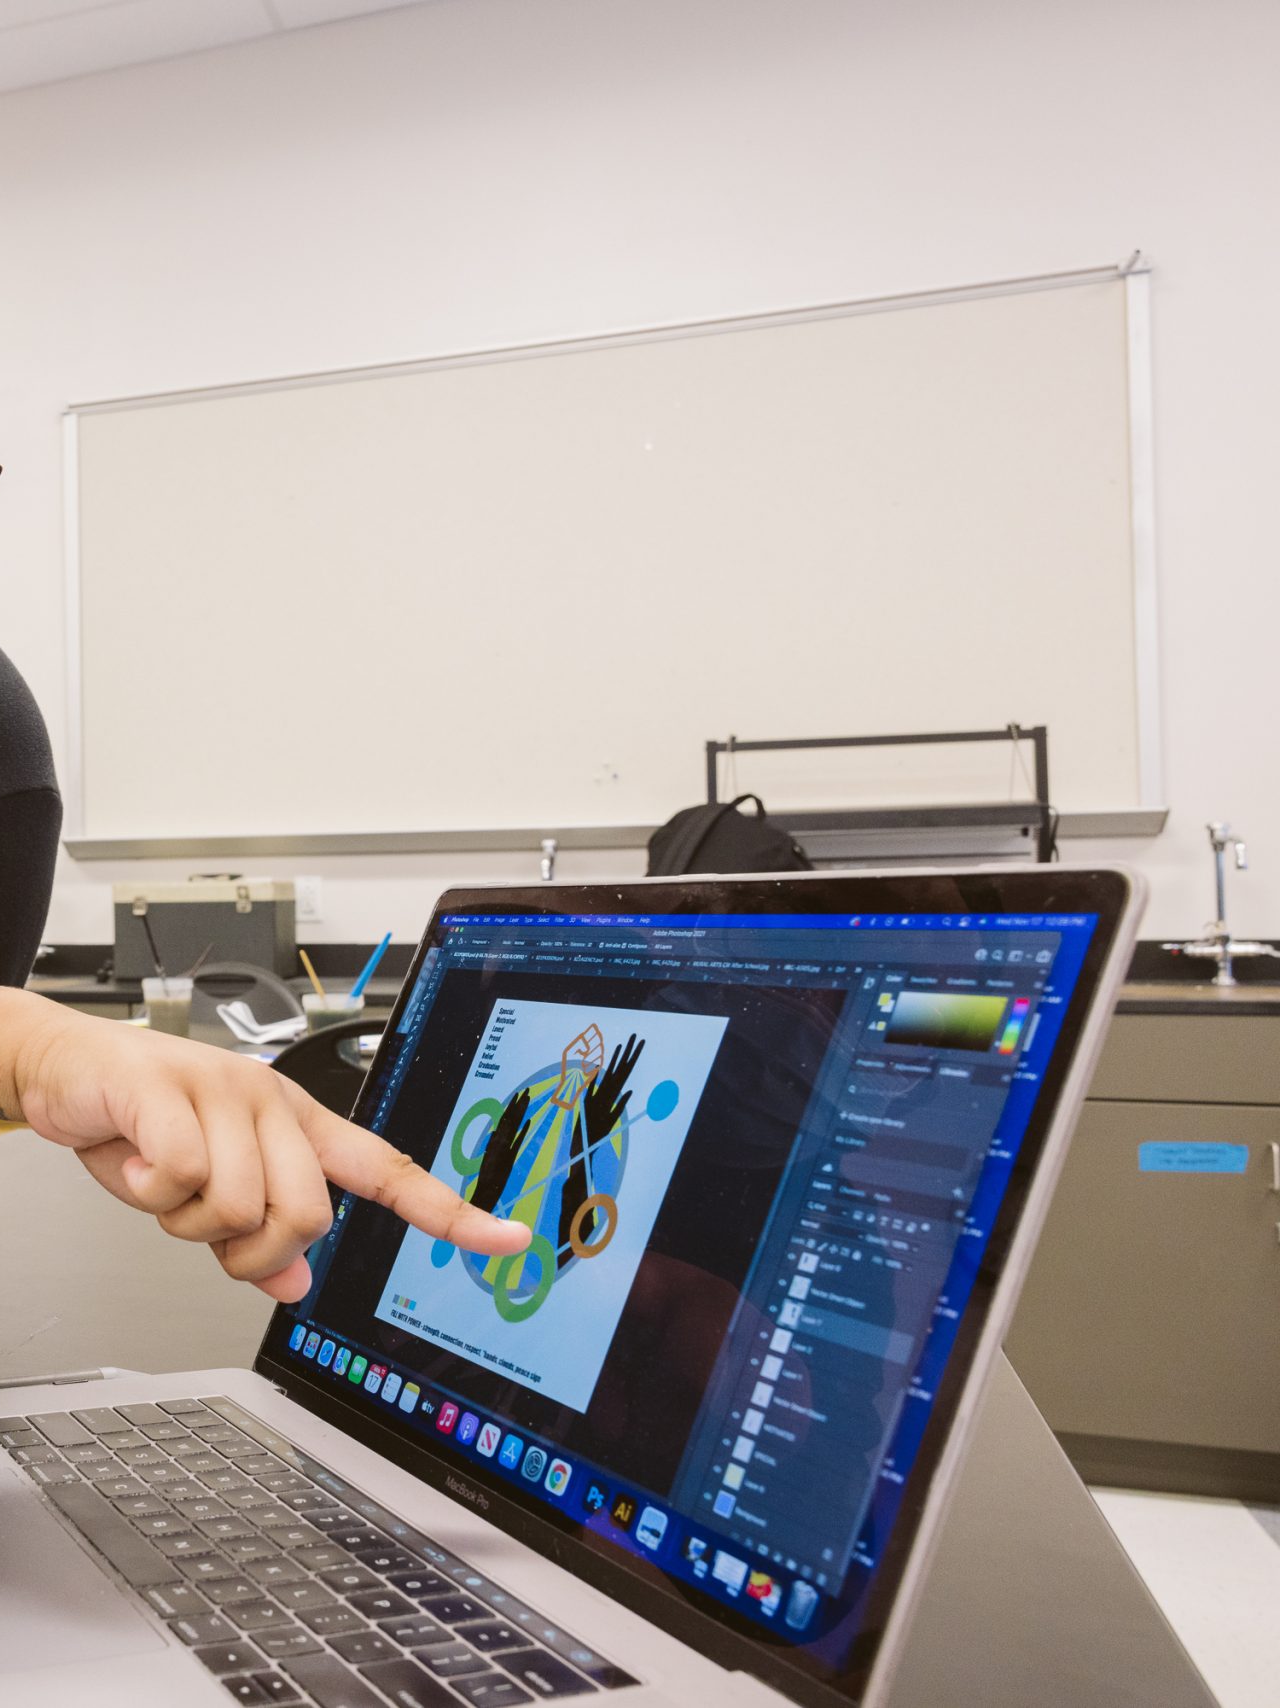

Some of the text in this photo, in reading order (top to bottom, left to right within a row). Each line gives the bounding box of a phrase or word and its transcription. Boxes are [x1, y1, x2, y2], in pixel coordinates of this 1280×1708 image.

[668, 930, 693, 938] Photoshop
[491, 1025, 504, 1033] Loved
[495, 1017, 516, 1025] Motivated
[488, 1034, 501, 1042] Proud
[478, 1061, 500, 1071] Graduation
[407, 1316, 421, 1328] POWER
[514, 1365, 530, 1379] peace
[530, 1372, 542, 1384] sign
[368, 1374, 379, 1389] 17
[445, 1475, 489, 1510] MacBook Pro
[587, 1486, 605, 1508] Ps
[614, 1502, 632, 1522] Ai
[175, 1541, 190, 1549] N
[197, 1563, 214, 1571] M
[266, 1566, 282, 1574] K
[293, 1590, 308, 1598] L
[406, 1580, 422, 1588] 0
[343, 1576, 359, 1584] O
[373, 1599, 391, 1608] P
